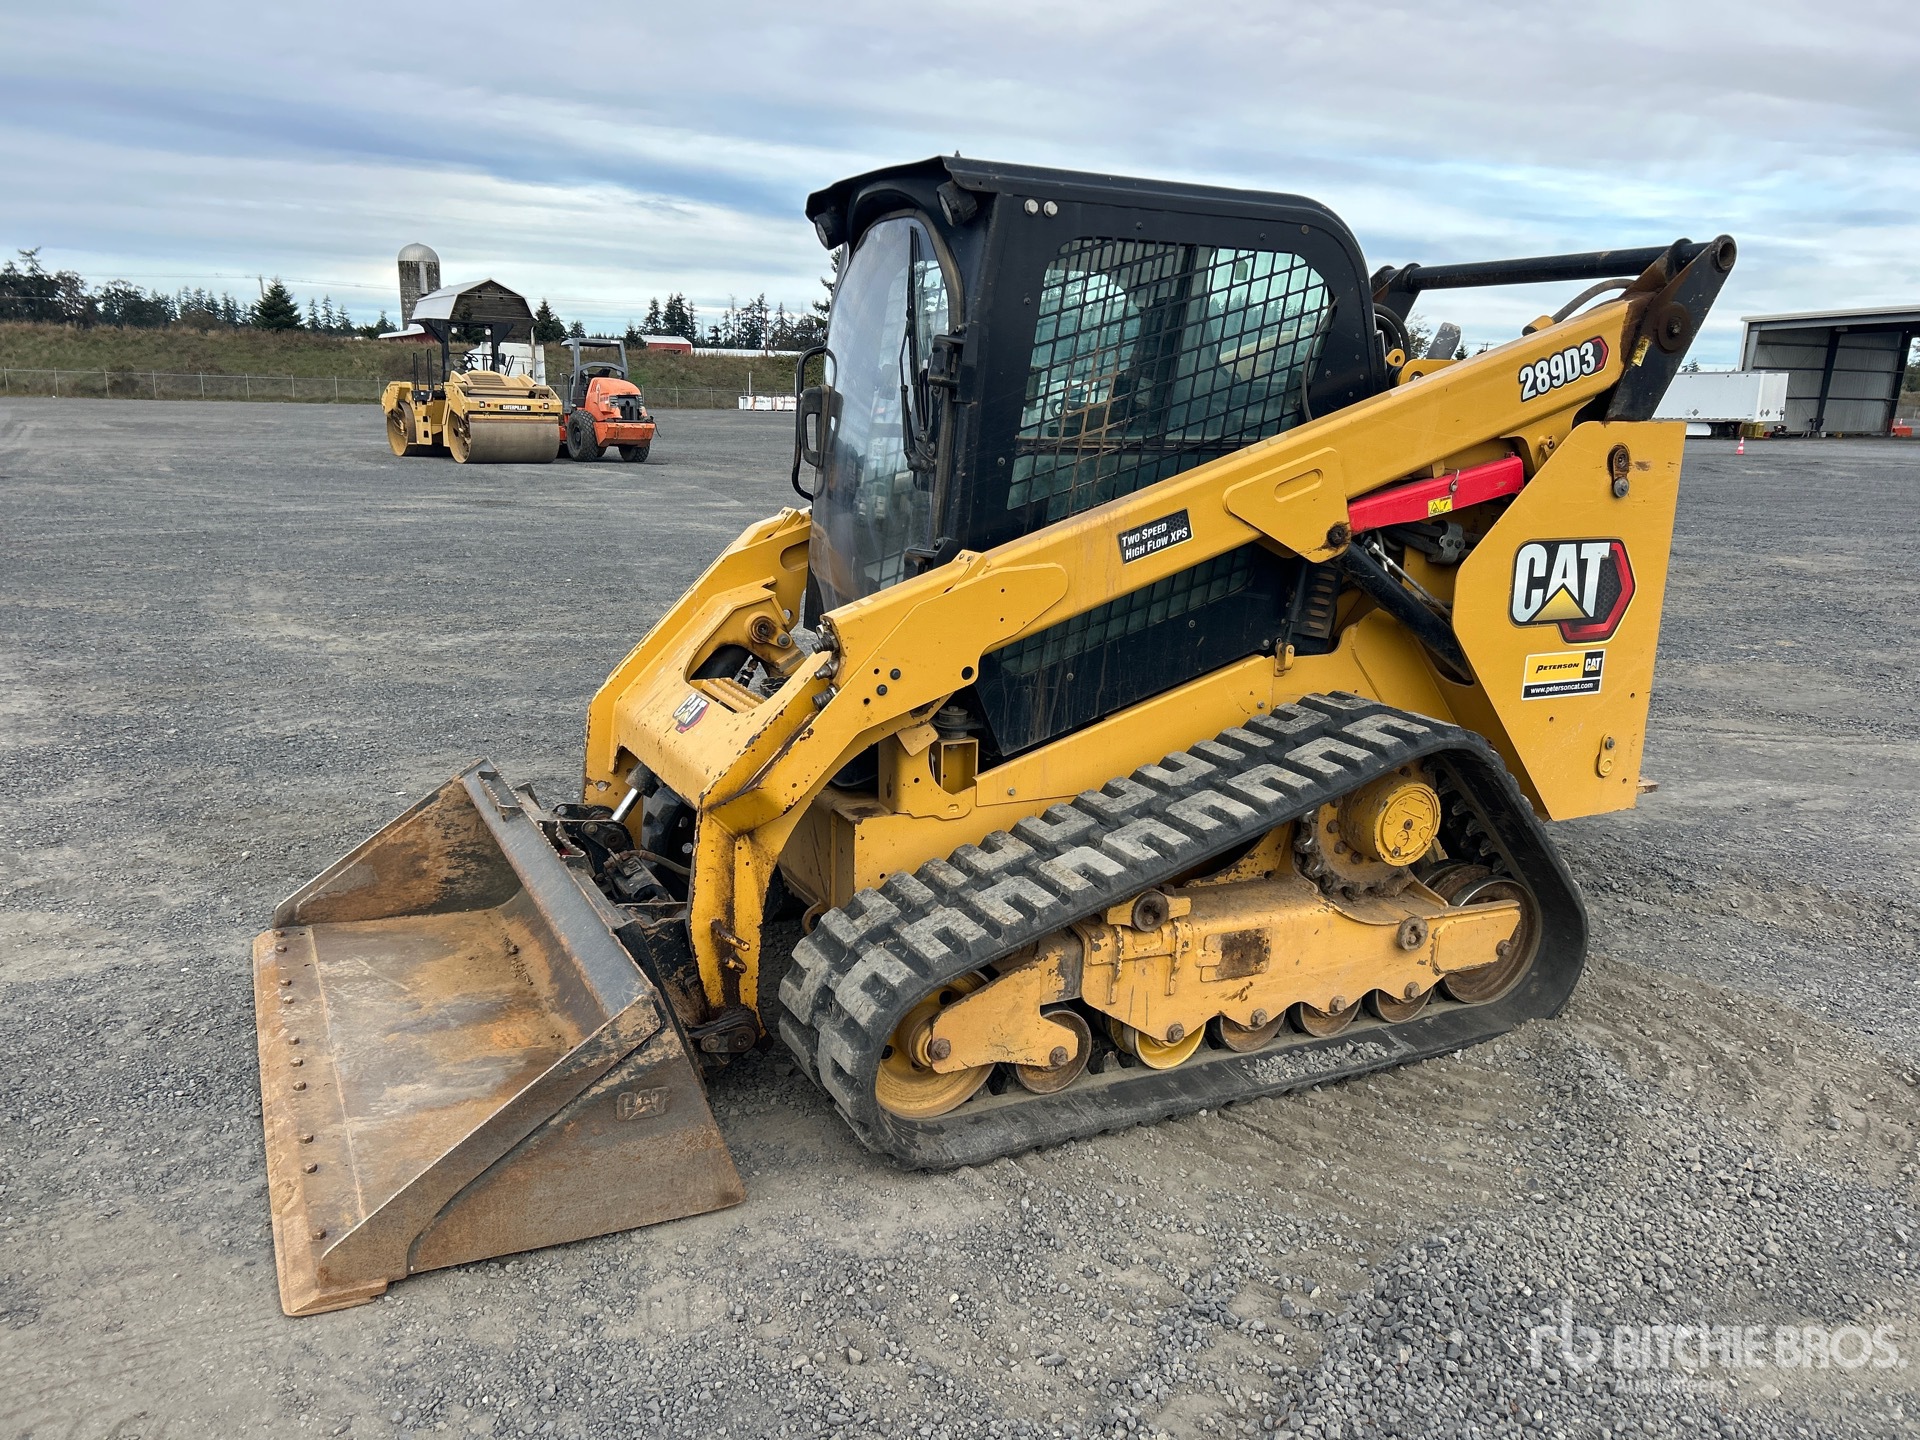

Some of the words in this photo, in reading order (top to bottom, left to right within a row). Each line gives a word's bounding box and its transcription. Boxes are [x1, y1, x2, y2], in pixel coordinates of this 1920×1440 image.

[1519, 341, 1596, 401] 289D3
[1170, 527, 1188, 543] XPS
[1512, 542, 1611, 623] CAT
[1536, 662, 1580, 674] PETERSON
[1585, 657, 1603, 672] CAT
[1530, 682, 1594, 694] www.petersoncat.com
[673, 692, 708, 725] CAT
[616, 1086, 670, 1121] CAT
